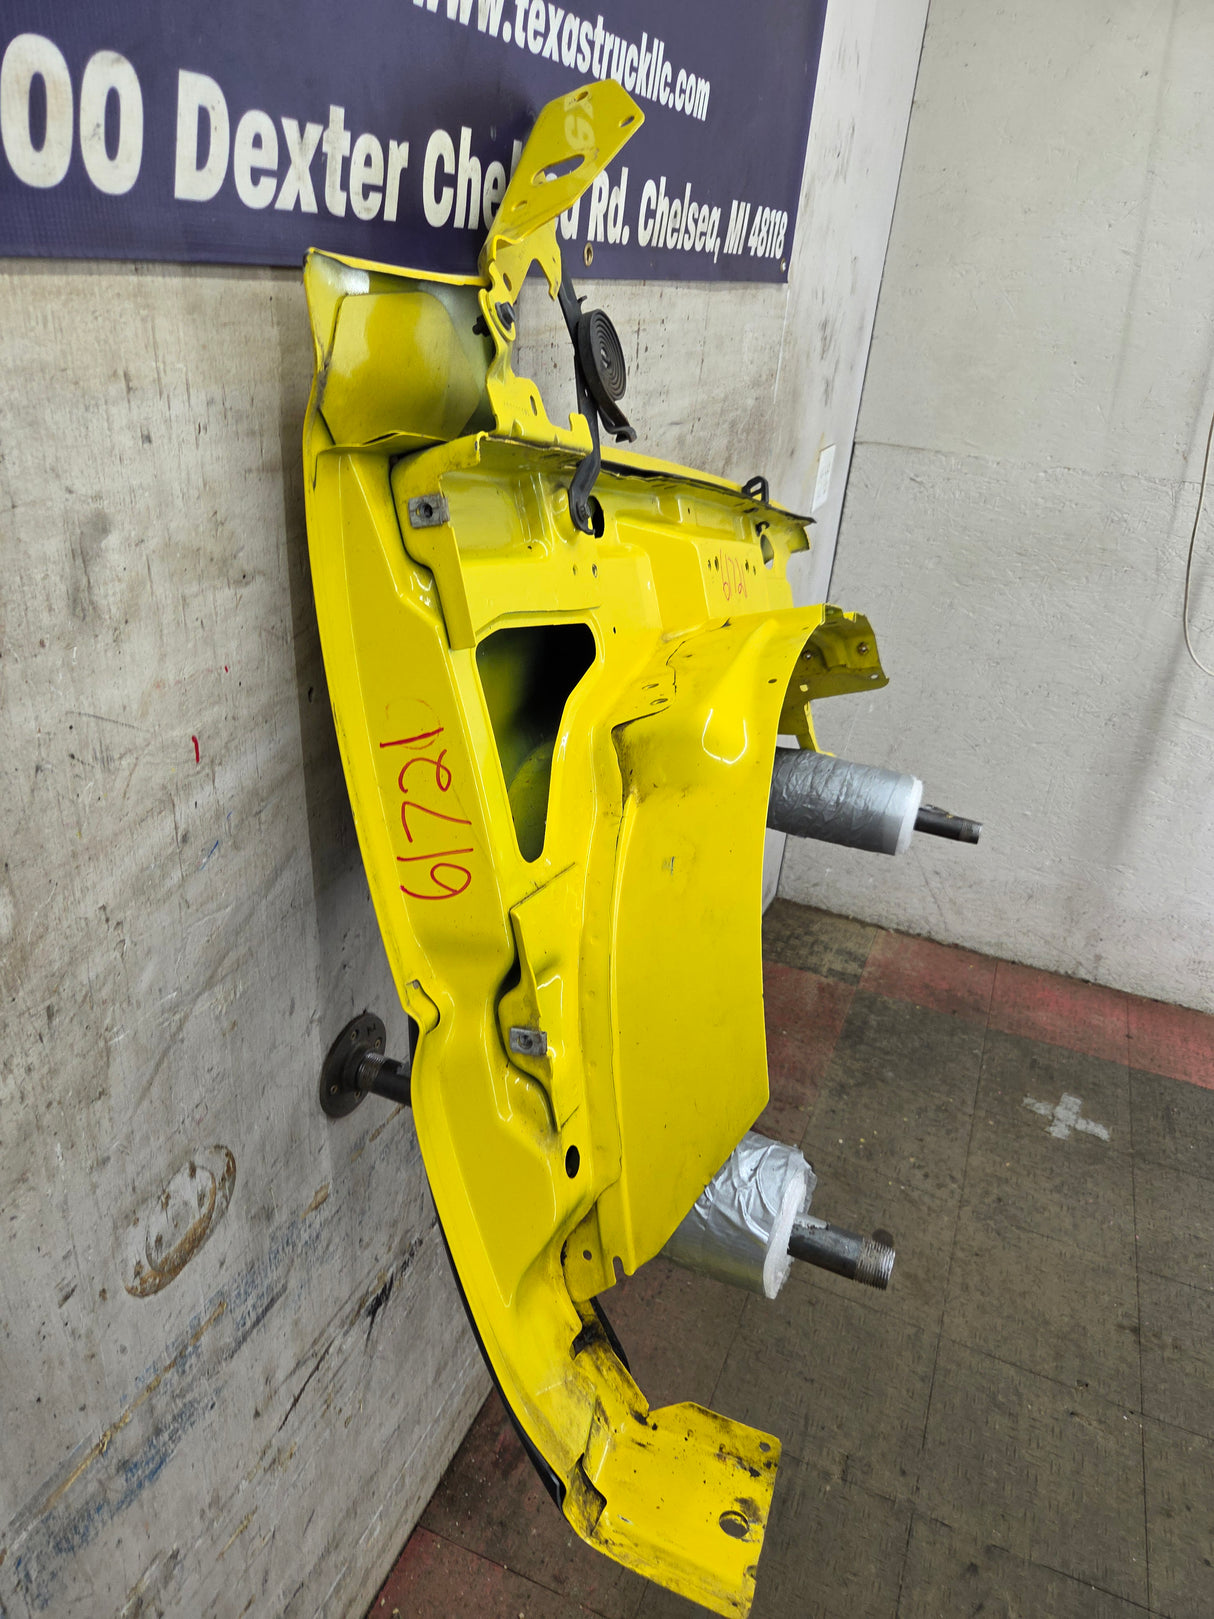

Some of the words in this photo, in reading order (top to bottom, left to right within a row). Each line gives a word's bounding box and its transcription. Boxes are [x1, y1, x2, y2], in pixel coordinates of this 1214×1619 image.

[413, 0, 710, 121] w.texastruckllc.com
[0, 33, 144, 195] 00
[174, 69, 409, 221] Dexter
[587, 167, 630, 245] Rd.
[638, 176, 721, 264] Chelsea,
[723, 200, 751, 255] MI
[748, 206, 788, 259] 48118
[379, 727, 474, 900] 61721
